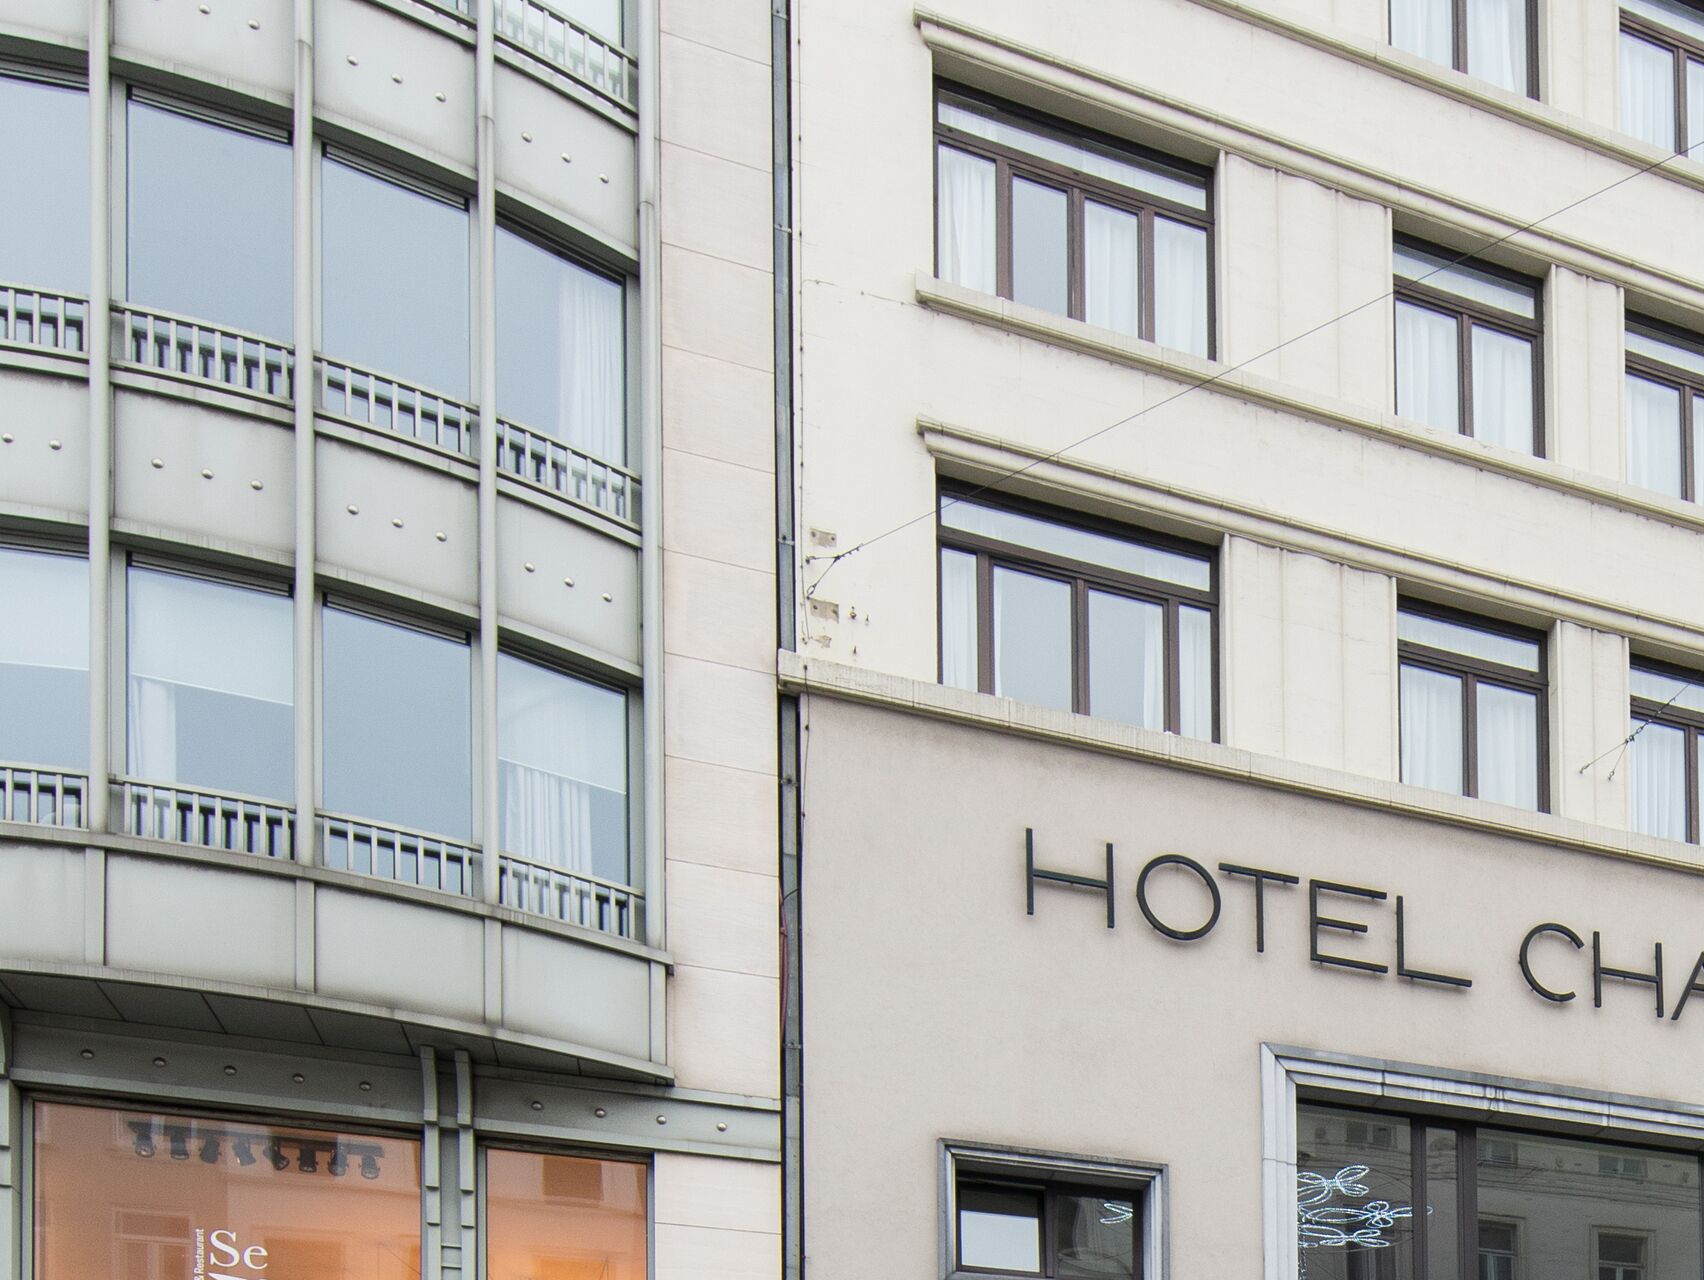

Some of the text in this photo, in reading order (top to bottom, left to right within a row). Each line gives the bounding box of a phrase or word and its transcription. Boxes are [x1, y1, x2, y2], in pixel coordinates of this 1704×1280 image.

[1026, 827, 1472, 989] HOTEL
[193, 1228, 205, 1274] Restaurant
[209, 1229, 269, 1270] Se
